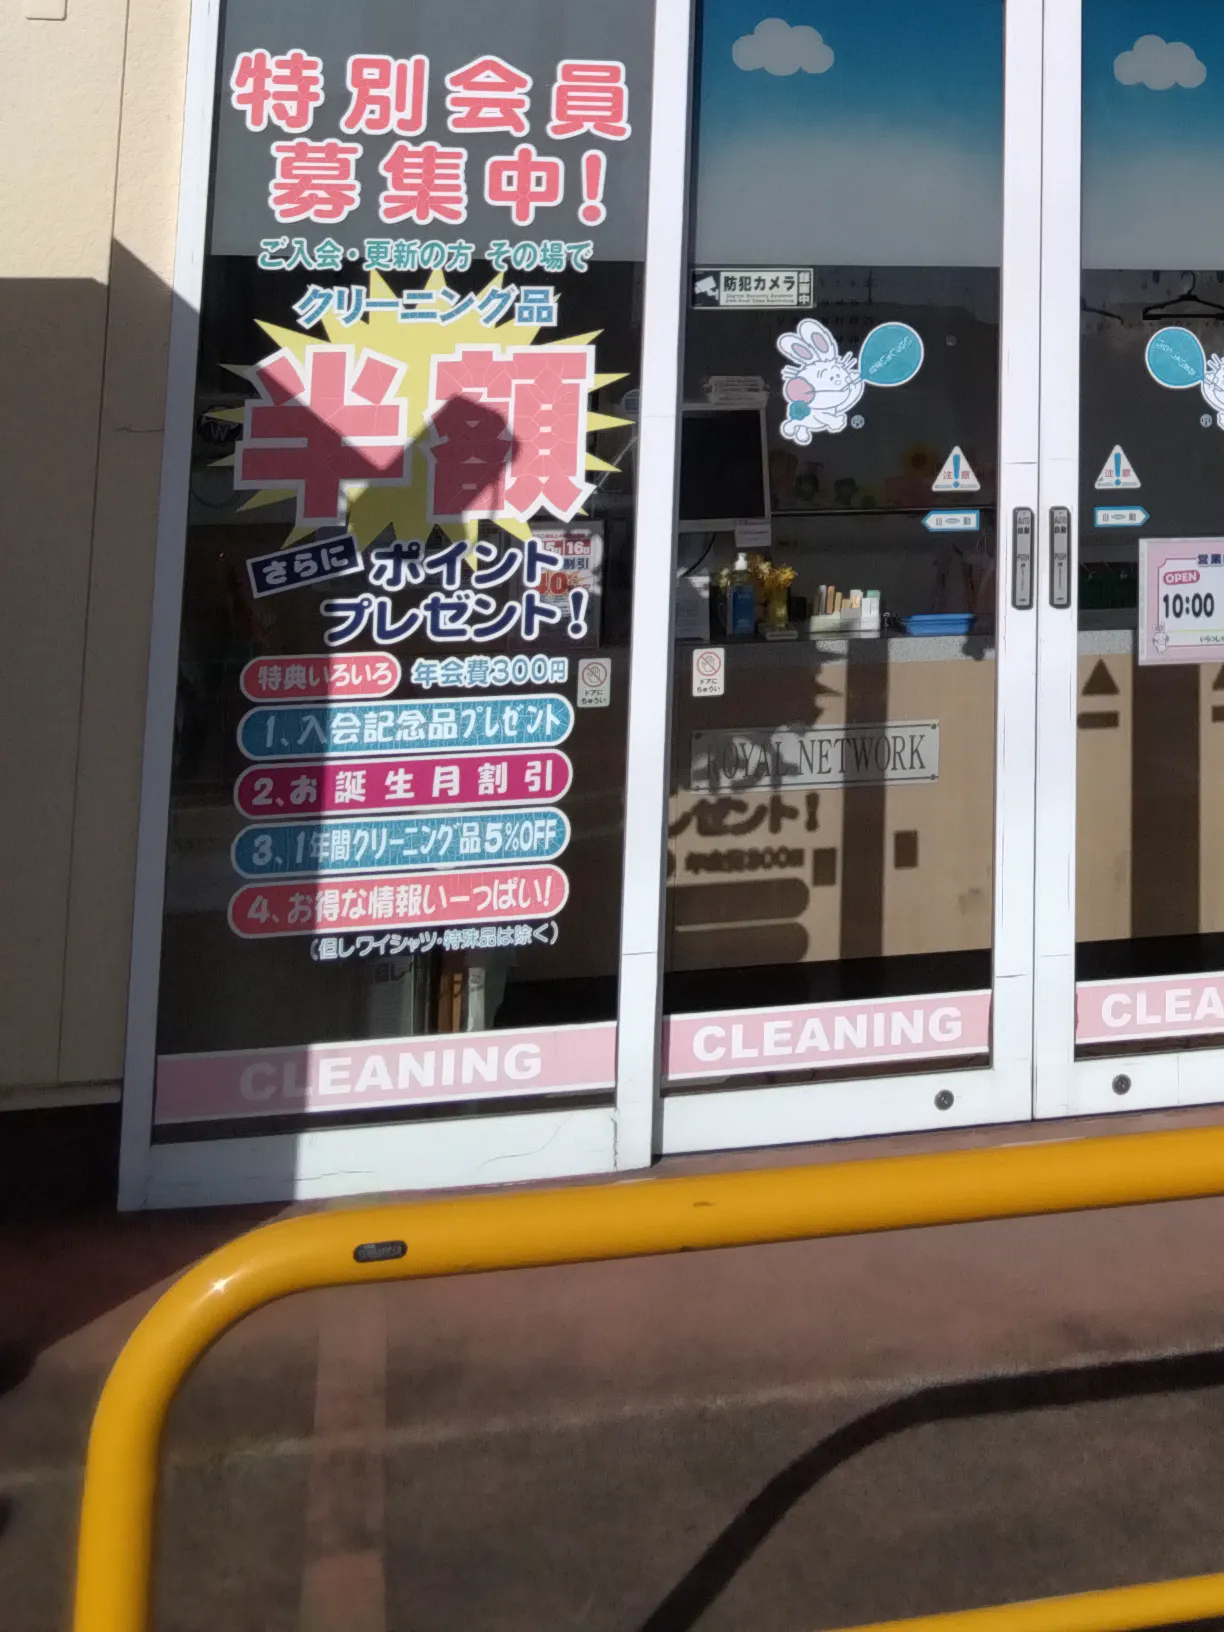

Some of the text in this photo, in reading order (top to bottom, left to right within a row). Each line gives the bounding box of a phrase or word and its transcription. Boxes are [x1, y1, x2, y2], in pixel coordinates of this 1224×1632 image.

[231, 49, 631, 140] 特別会員
[269, 138, 607, 226] 募集中!
[258, 236, 593, 272] ご入会・更新の方 その場で
[724, 276, 795, 291] 防犯カメラ
[292, 284, 557, 330] クリーニング品
[234, 344, 597, 526] 半額
[262, 537, 563, 592] さらに ポイント
[1165, 572, 1197, 584] OPEN
[320, 588, 589, 647] プレゼント!
[1163, 592, 1214, 618] 10:00
[257, 662, 393, 691] 特典いろいろ
[411, 655, 569, 689] 年会費300円
[707, 734, 926, 780] ROYAL NETWORK
[693, 1006, 962, 1062] CLEANING
[239, 1042, 542, 1101] CLEANING
